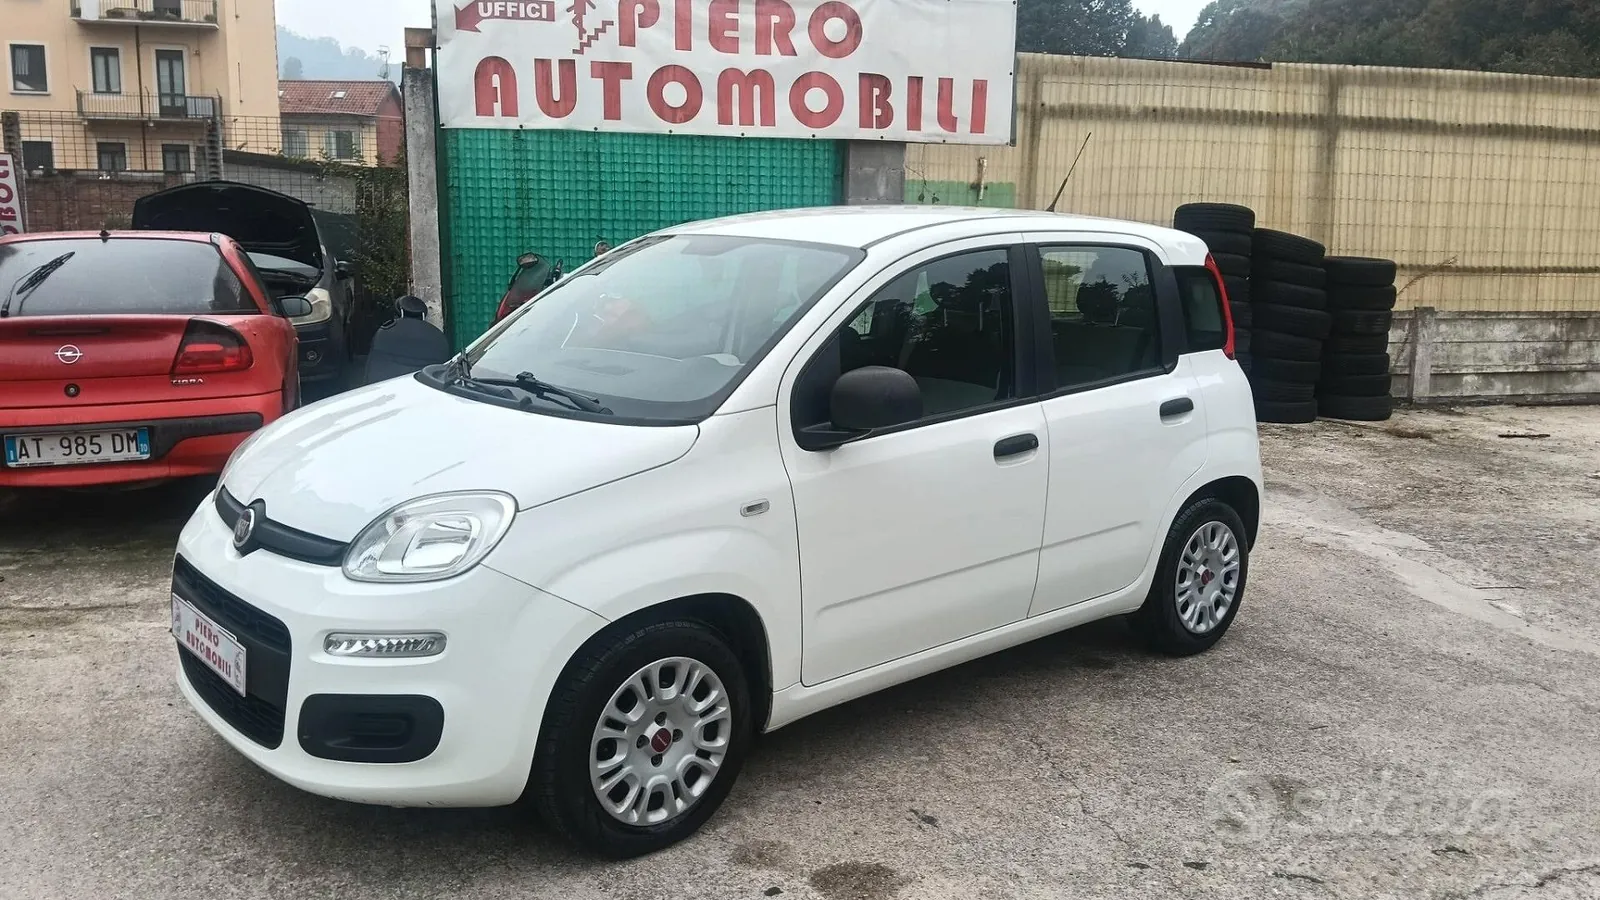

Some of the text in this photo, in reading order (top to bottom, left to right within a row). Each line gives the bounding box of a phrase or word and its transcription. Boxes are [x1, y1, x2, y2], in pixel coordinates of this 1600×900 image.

[478, 2, 547, 19] UFFICI
[618, 0, 863, 59] PIERO
[474, 56, 988, 134] AUTOMOBILI
[18, 438, 43, 459] AT
[60, 435, 103, 456] 985
[111, 432, 139, 453] DM
[195, 618, 220, 648] PIERO
[186, 630, 232, 679] AUTOMOBILI
